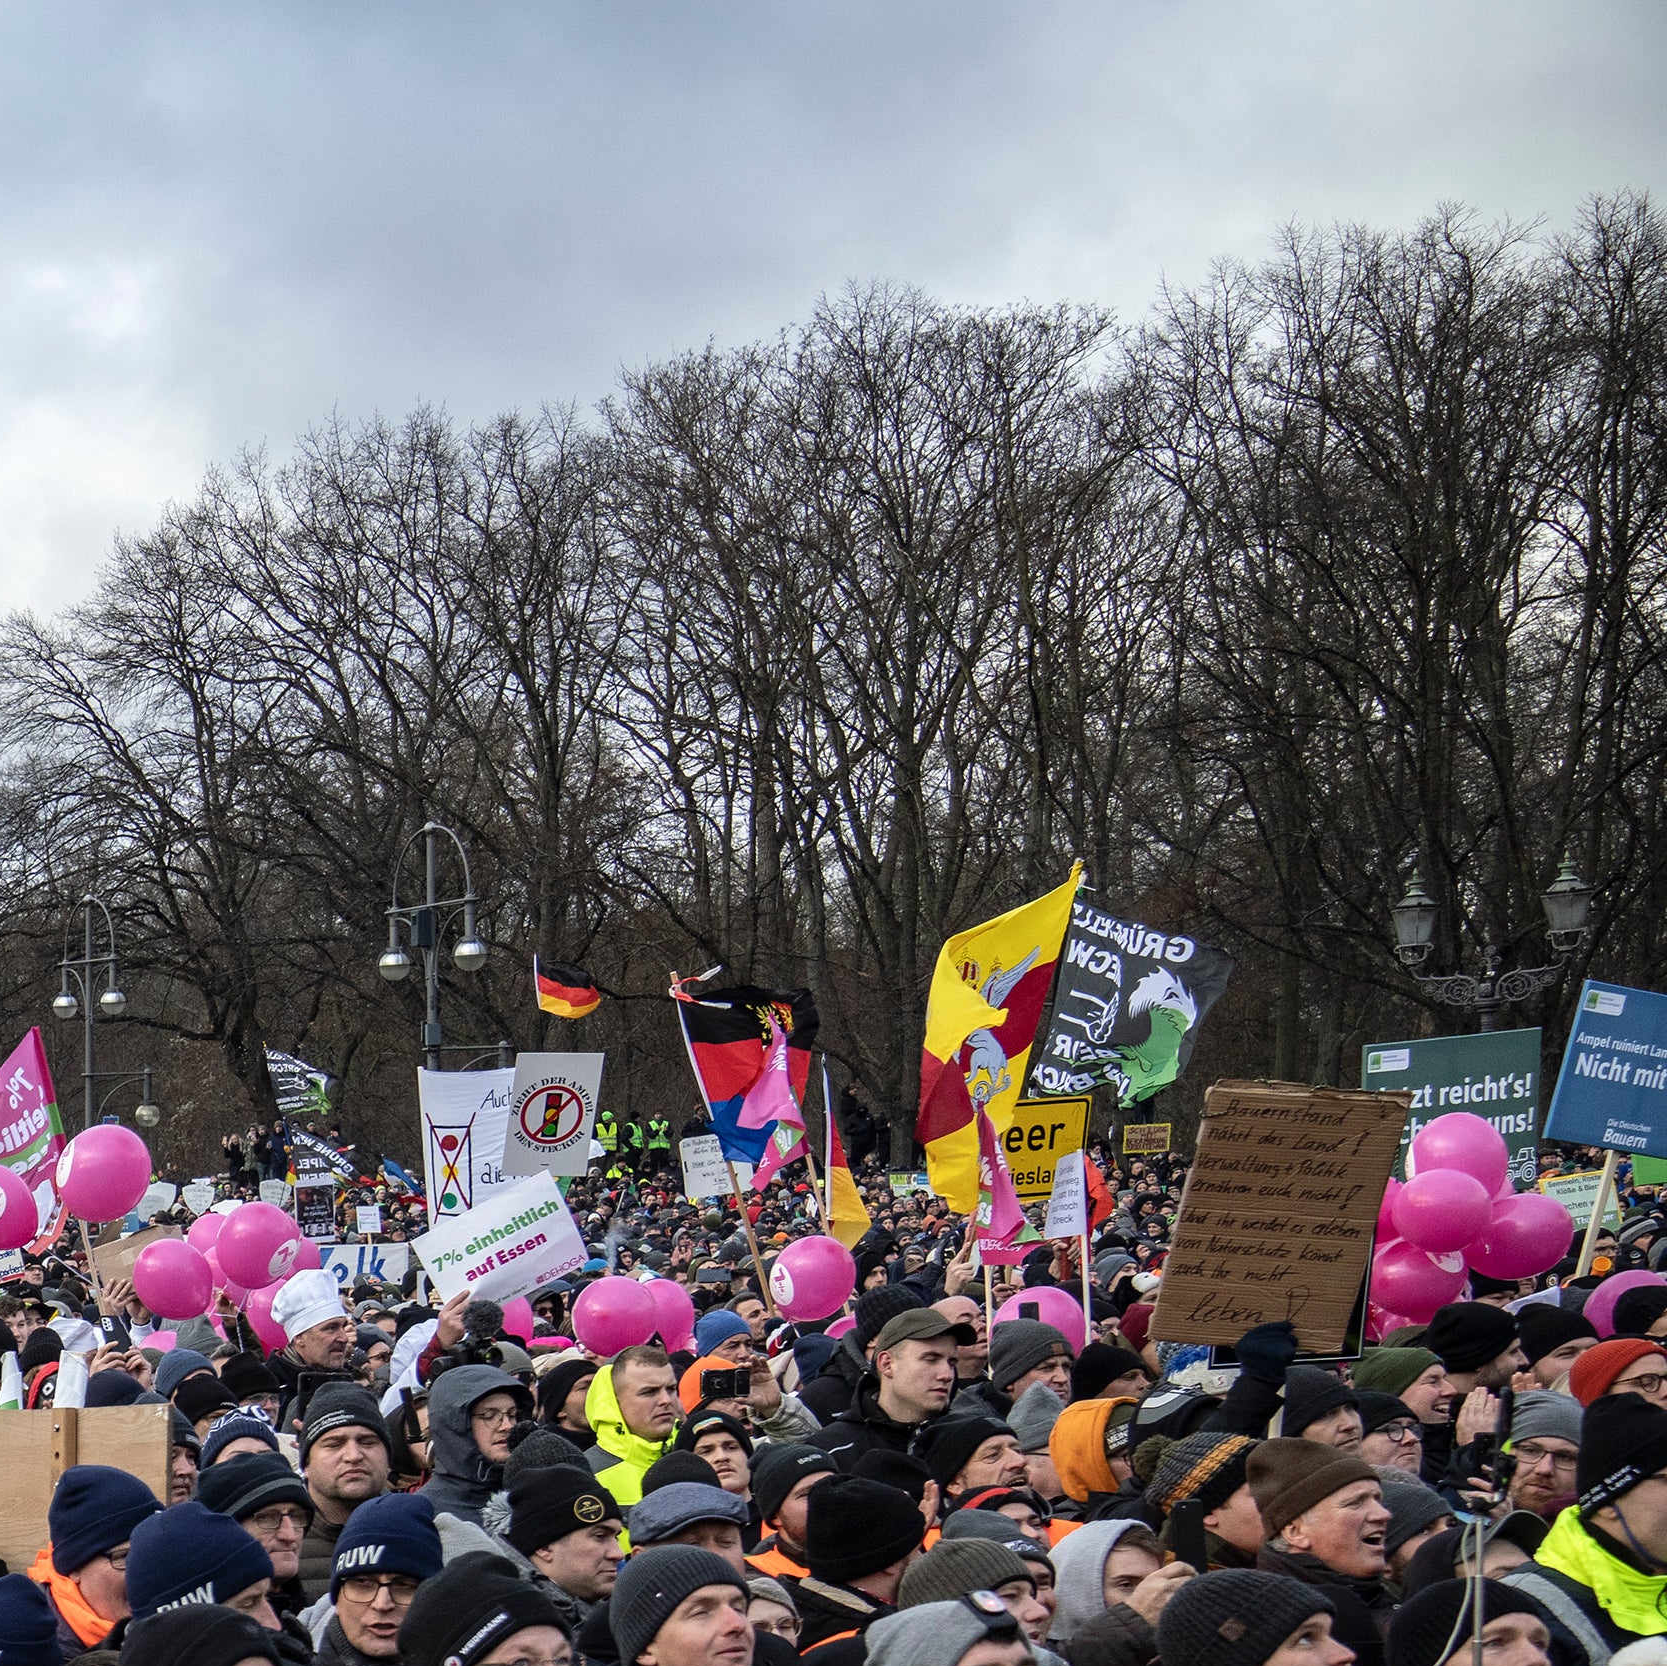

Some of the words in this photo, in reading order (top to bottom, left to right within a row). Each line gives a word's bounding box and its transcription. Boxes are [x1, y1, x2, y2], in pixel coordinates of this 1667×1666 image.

[1576, 1031, 1611, 1049] Ampel
[1611, 1040, 1649, 1055] ruiniert
[1574, 1052, 1627, 1083] Nicht
[1633, 1064, 1667, 1090] mit
[512, 1082, 538, 1117] ZIEHT
[540, 1076, 567, 1087] DER
[568, 1081, 594, 1117] AMPEL
[1226, 1099, 1354, 1127] Bauernstand
[1005, 1121, 1067, 1153] eer
[1208, 1125, 1251, 1141] nährt
[1257, 1131, 1285, 1146] das
[1606, 1118, 1619, 1128] Die
[1618, 1120, 1652, 1133] Deutschen
[513, 1130, 533, 1149] DEN
[533, 1130, 586, 1154] STECKER
[1602, 1129, 1647, 1149] Bauern
[480, 1162, 504, 1185] die
[1197, 1151, 1285, 1179] Verwaltung
[1295, 1158, 1350, 1181] Politik
[1258, 1183, 1292, 1199] euch
[1298, 1186, 1345, 1202] nicht
[1556, 1186, 1577, 1196] Klöße
[1052, 1214, 1074, 1226] Dreck
[1216, 1214, 1235, 1230] ihr
[1241, 1217, 1287, 1234] werdet
[1289, 1222, 1304, 1235] es
[1311, 1217, 1362, 1239] erleben
[430, 1248, 464, 1273] 7%
[466, 1199, 561, 1256] einheitlich
[1175, 1238, 1202, 1250] von
[1204, 1236, 1289, 1260] Naturschutz
[466, 1256, 495, 1282] auf
[494, 1232, 549, 1265] Essen
[543, 1254, 586, 1280] DEHOGA
[1171, 1260, 1205, 1278] auch
[1243, 1265, 1301, 1283] nicht
[337, 1544, 386, 1572] RUW
[459, 1612, 510, 1655] WEIDEMANN
